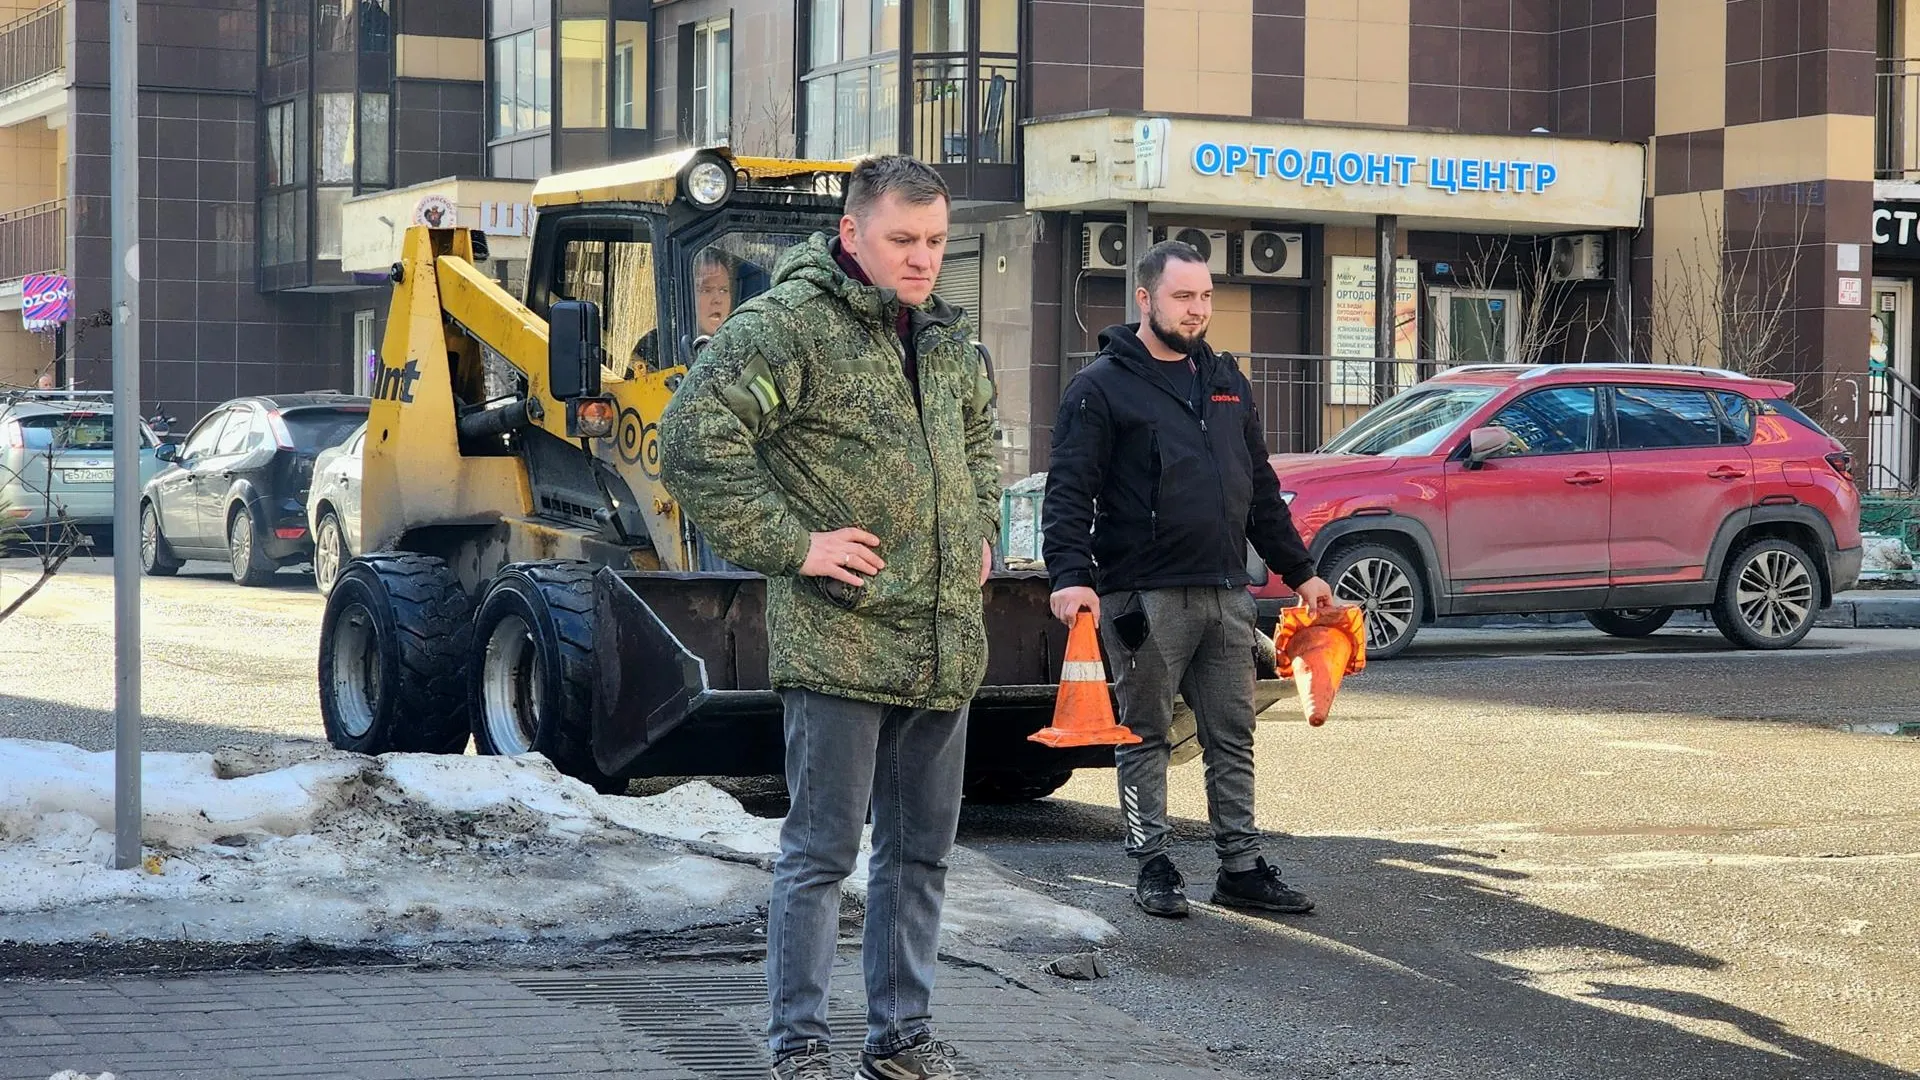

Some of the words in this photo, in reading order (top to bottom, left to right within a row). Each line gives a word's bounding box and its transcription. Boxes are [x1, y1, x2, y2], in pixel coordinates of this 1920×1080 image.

[1194, 142, 1417, 187] ОРТОДОНТ
[1427, 156, 1558, 195] ЦЕНТР
[1336, 290, 1376, 300] ОРТОДОН
